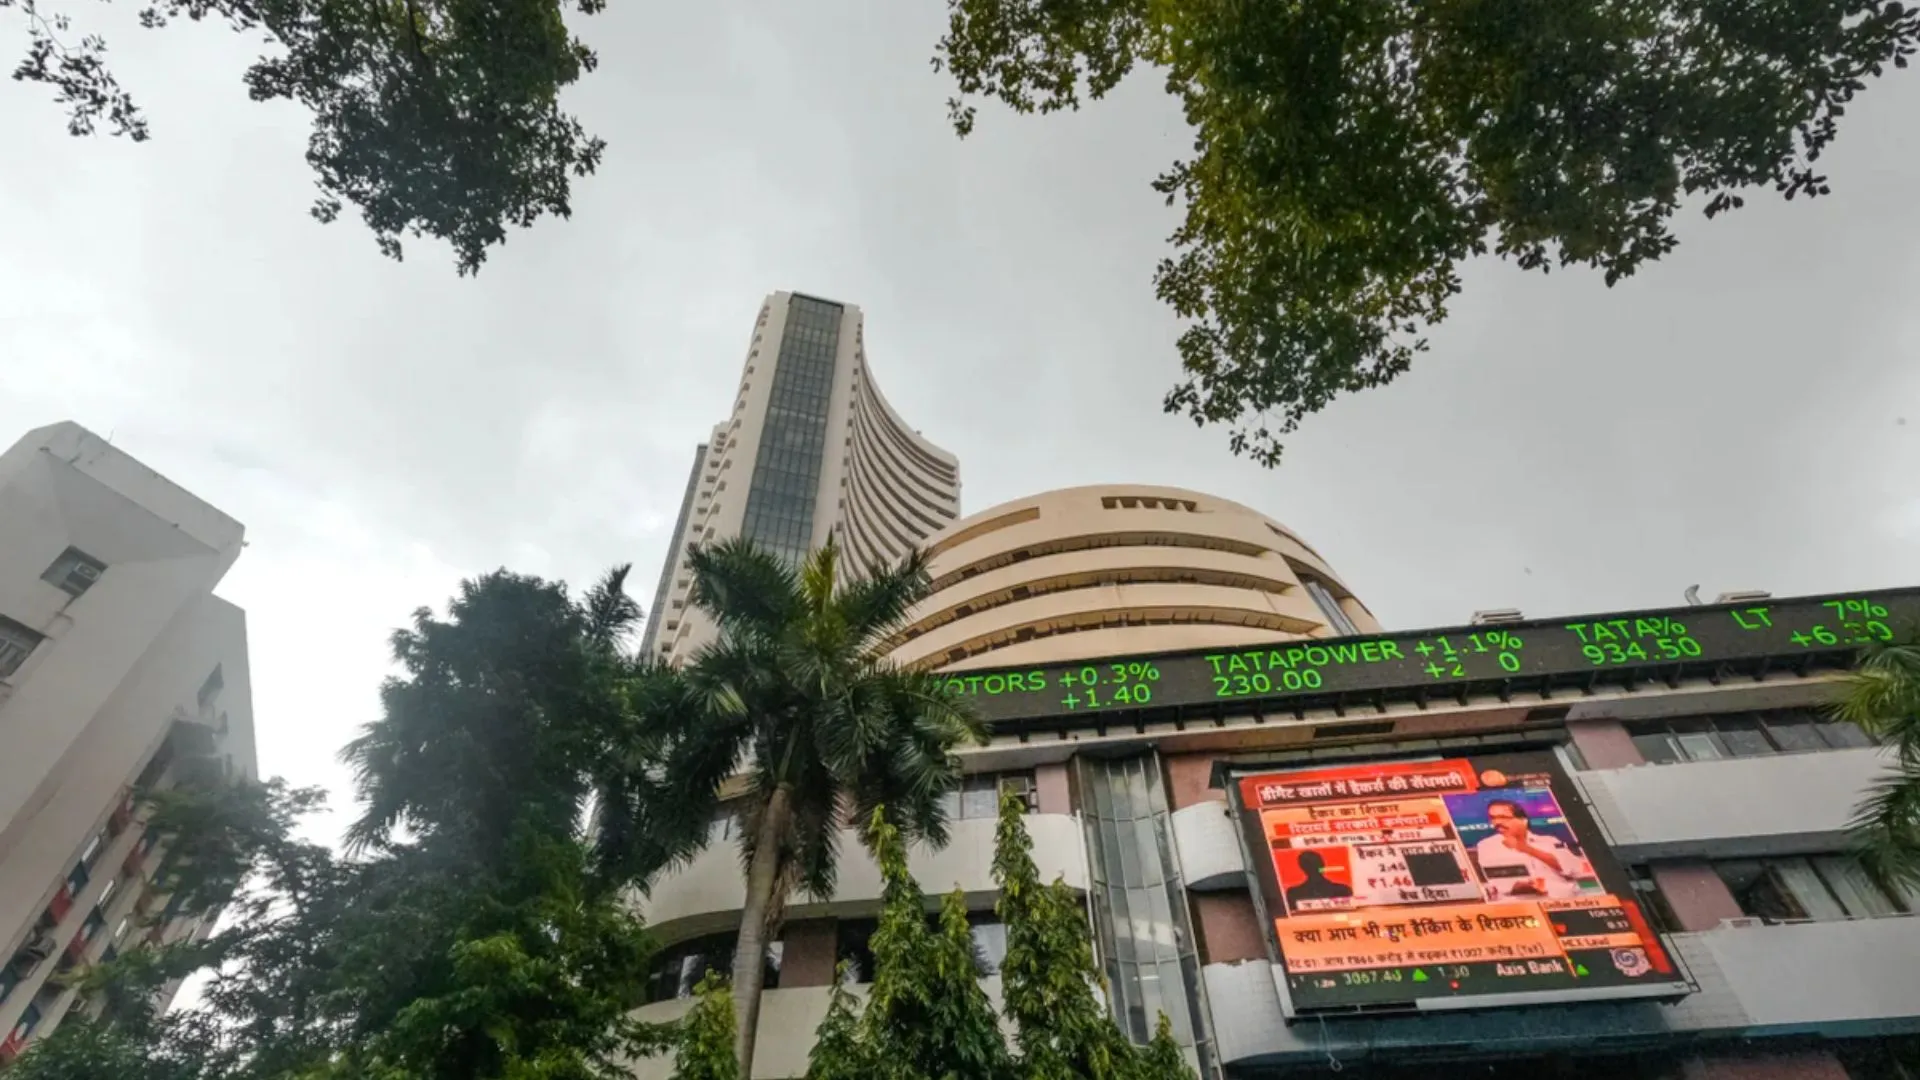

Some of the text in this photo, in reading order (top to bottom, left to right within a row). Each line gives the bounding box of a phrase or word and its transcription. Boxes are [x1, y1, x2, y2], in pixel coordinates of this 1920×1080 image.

[1730, 607, 1773, 630] LT
[1205, 630, 1523, 674] TATAPOWER +1.1%
[1582, 636, 1702, 665] 934.50
[933, 662, 1160, 697] OTORS +0.3%
[1213, 669, 1322, 697] 230.00
[1061, 683, 1151, 710] +1.40
[1387, 775, 1408, 791] की
[1292, 928, 1323, 943] क्या
[1326, 926, 1357, 942] आप
[1362, 921, 1381, 938] भी
[1456, 915, 1473, 932] के
[1496, 958, 1565, 976] Axis Bank
